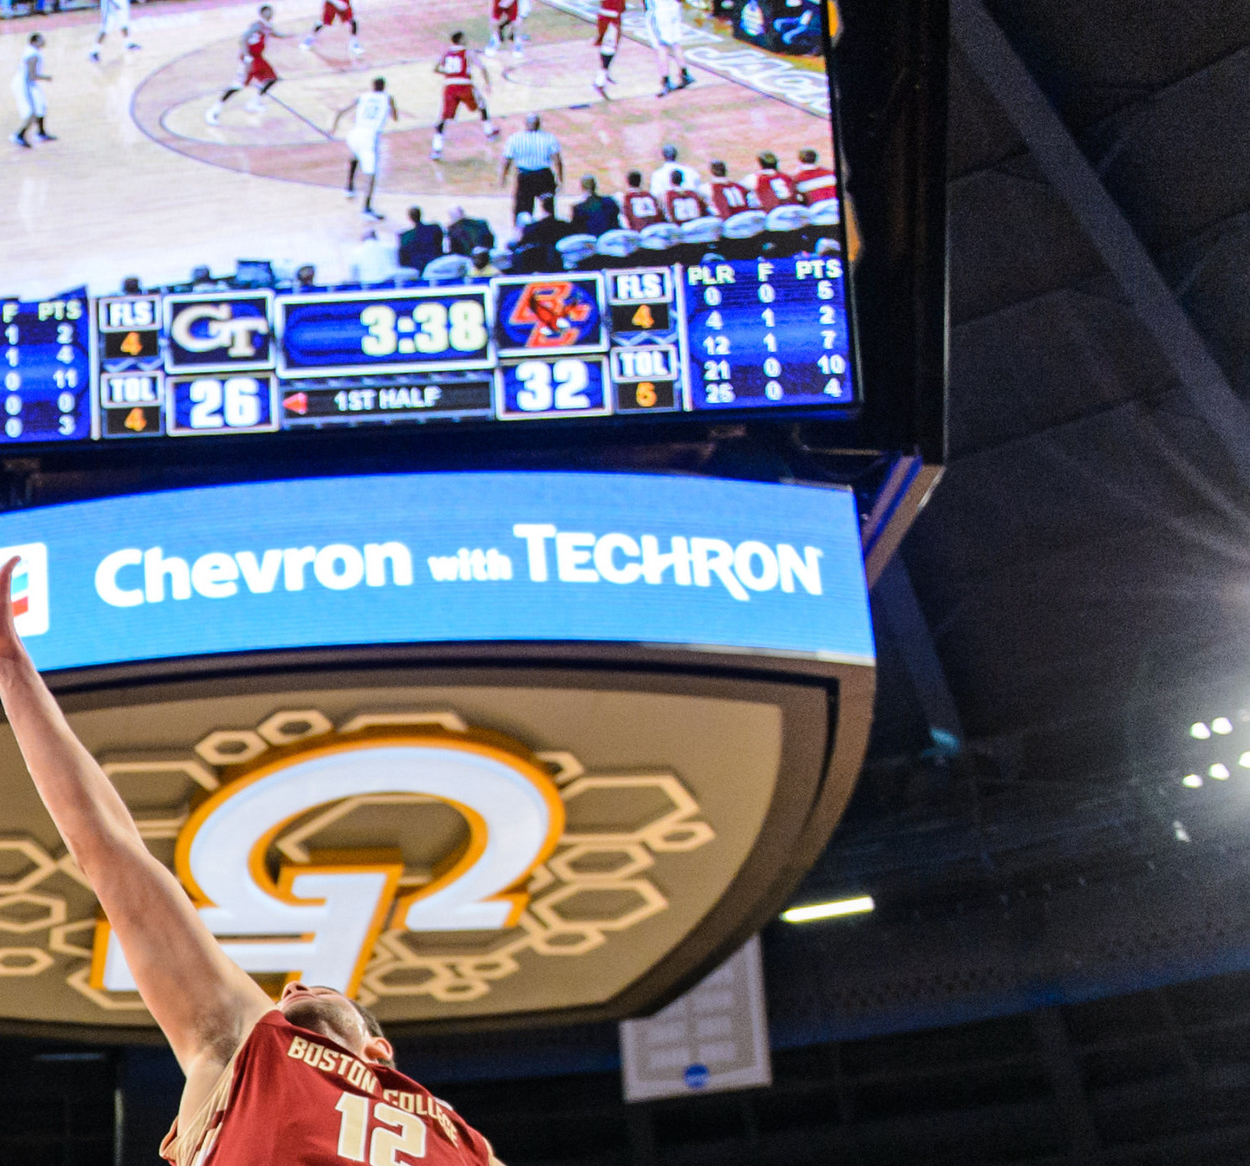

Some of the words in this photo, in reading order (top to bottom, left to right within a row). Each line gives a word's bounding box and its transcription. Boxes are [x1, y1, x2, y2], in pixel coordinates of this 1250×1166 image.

[687, 264, 736, 286] PLR
[757, 262, 775, 283] F
[795, 258, 843, 280] PTS
[616, 273, 662, 300] FLS
[703, 286, 722, 306] 0
[758, 283, 776, 304] 0
[2, 301, 19, 324] F
[38, 300, 82, 322] PTS
[110, 301, 152, 327] FLS
[631, 304, 655, 329] 4
[705, 310, 724, 330] 4
[761, 307, 776, 327] 1
[819, 304, 836, 325] 2
[5, 323, 19, 345] 1
[56, 322, 73, 344] 2
[359, 299, 488, 357] 3:38
[120, 331, 143, 356] 4
[702, 335, 731, 355] 12
[763, 333, 778, 353] 1
[820, 329, 837, 350] 7
[5, 346, 19, 367] 1
[56, 344, 74, 365] 4
[619, 350, 669, 377] TOL
[703, 360, 732, 381] 21
[763, 357, 782, 378] 0
[816, 354, 846, 374] 10
[4, 370, 21, 391] 0
[52, 368, 78, 389] 11
[110, 377, 156, 402] TOL
[515, 359, 591, 411] 32
[765, 380, 784, 401] 0
[823, 377, 843, 398] 4
[4, 394, 22, 416] 0
[57, 391, 75, 413] 0
[189, 378, 261, 429] 26
[334, 388, 377, 412] 1ST
[378, 385, 442, 410] HALF
[4, 416, 22, 438] 0
[58, 414, 76, 436] 3
[124, 407, 147, 432] 4
[94, 541, 414, 608] Chevron
[426, 547, 513, 582] with
[512, 523, 825, 602] TECHRON
[287, 1035, 379, 1095] BOSTON
